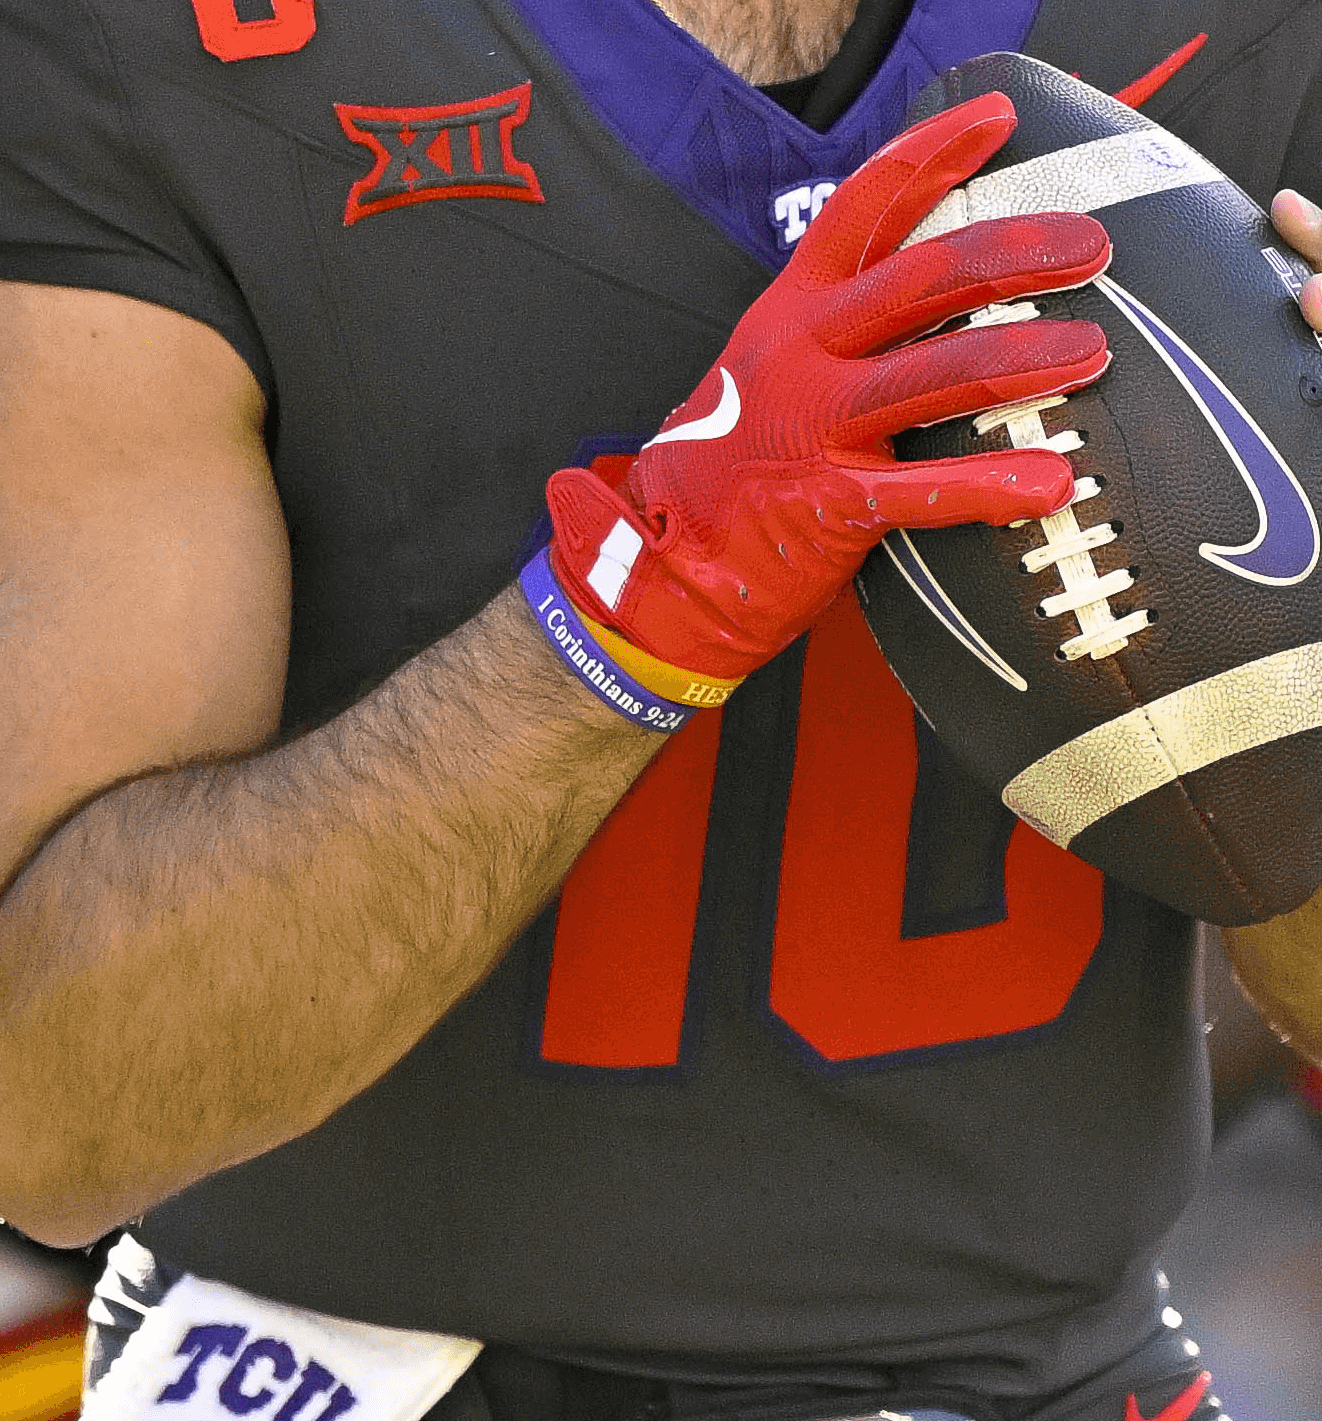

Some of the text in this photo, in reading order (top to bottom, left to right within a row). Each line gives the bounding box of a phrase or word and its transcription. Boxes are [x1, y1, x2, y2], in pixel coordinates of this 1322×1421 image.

[537, 594, 685, 730] 1 Corinthians 9:24
[156, 1323, 358, 1421] TCU
